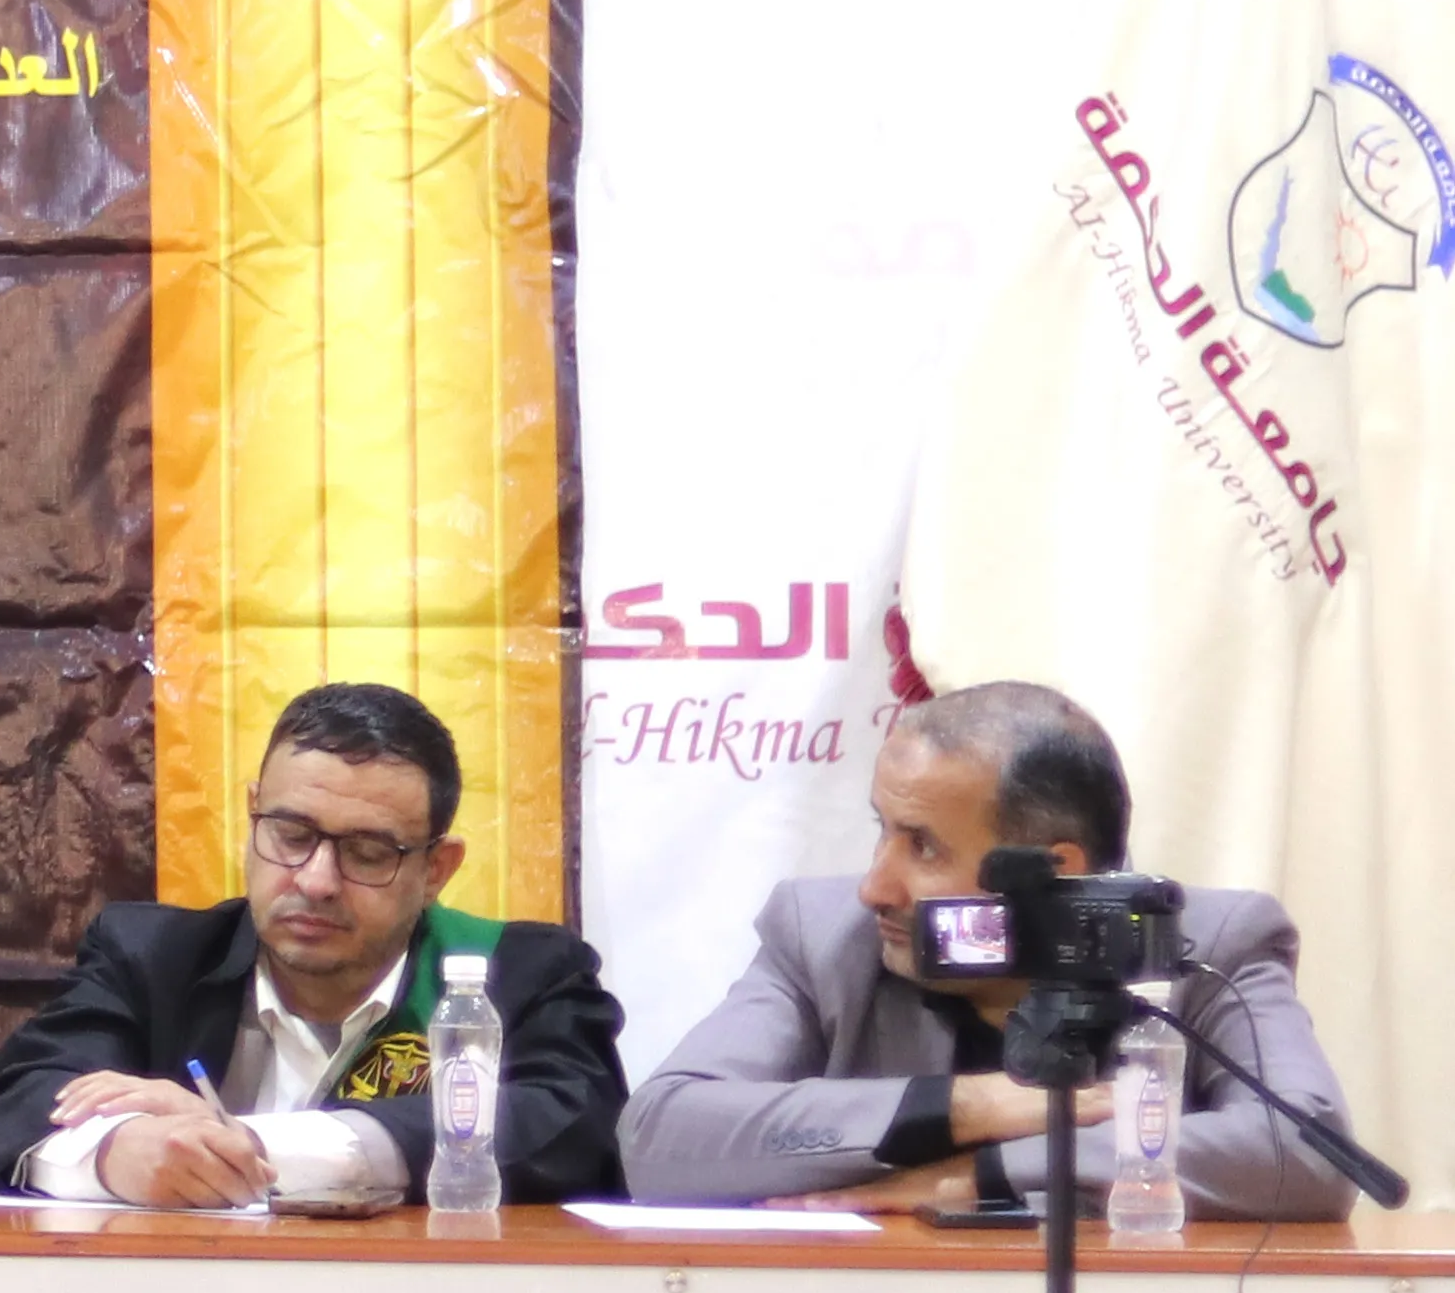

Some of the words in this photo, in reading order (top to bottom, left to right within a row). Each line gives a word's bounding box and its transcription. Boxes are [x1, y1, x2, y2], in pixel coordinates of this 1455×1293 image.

[1155, 375, 1298, 583] University
[1199, 334, 1348, 588] جامعة
[582, 581, 850, 661] الحك
[582, 691, 846, 782] l-Hikma
